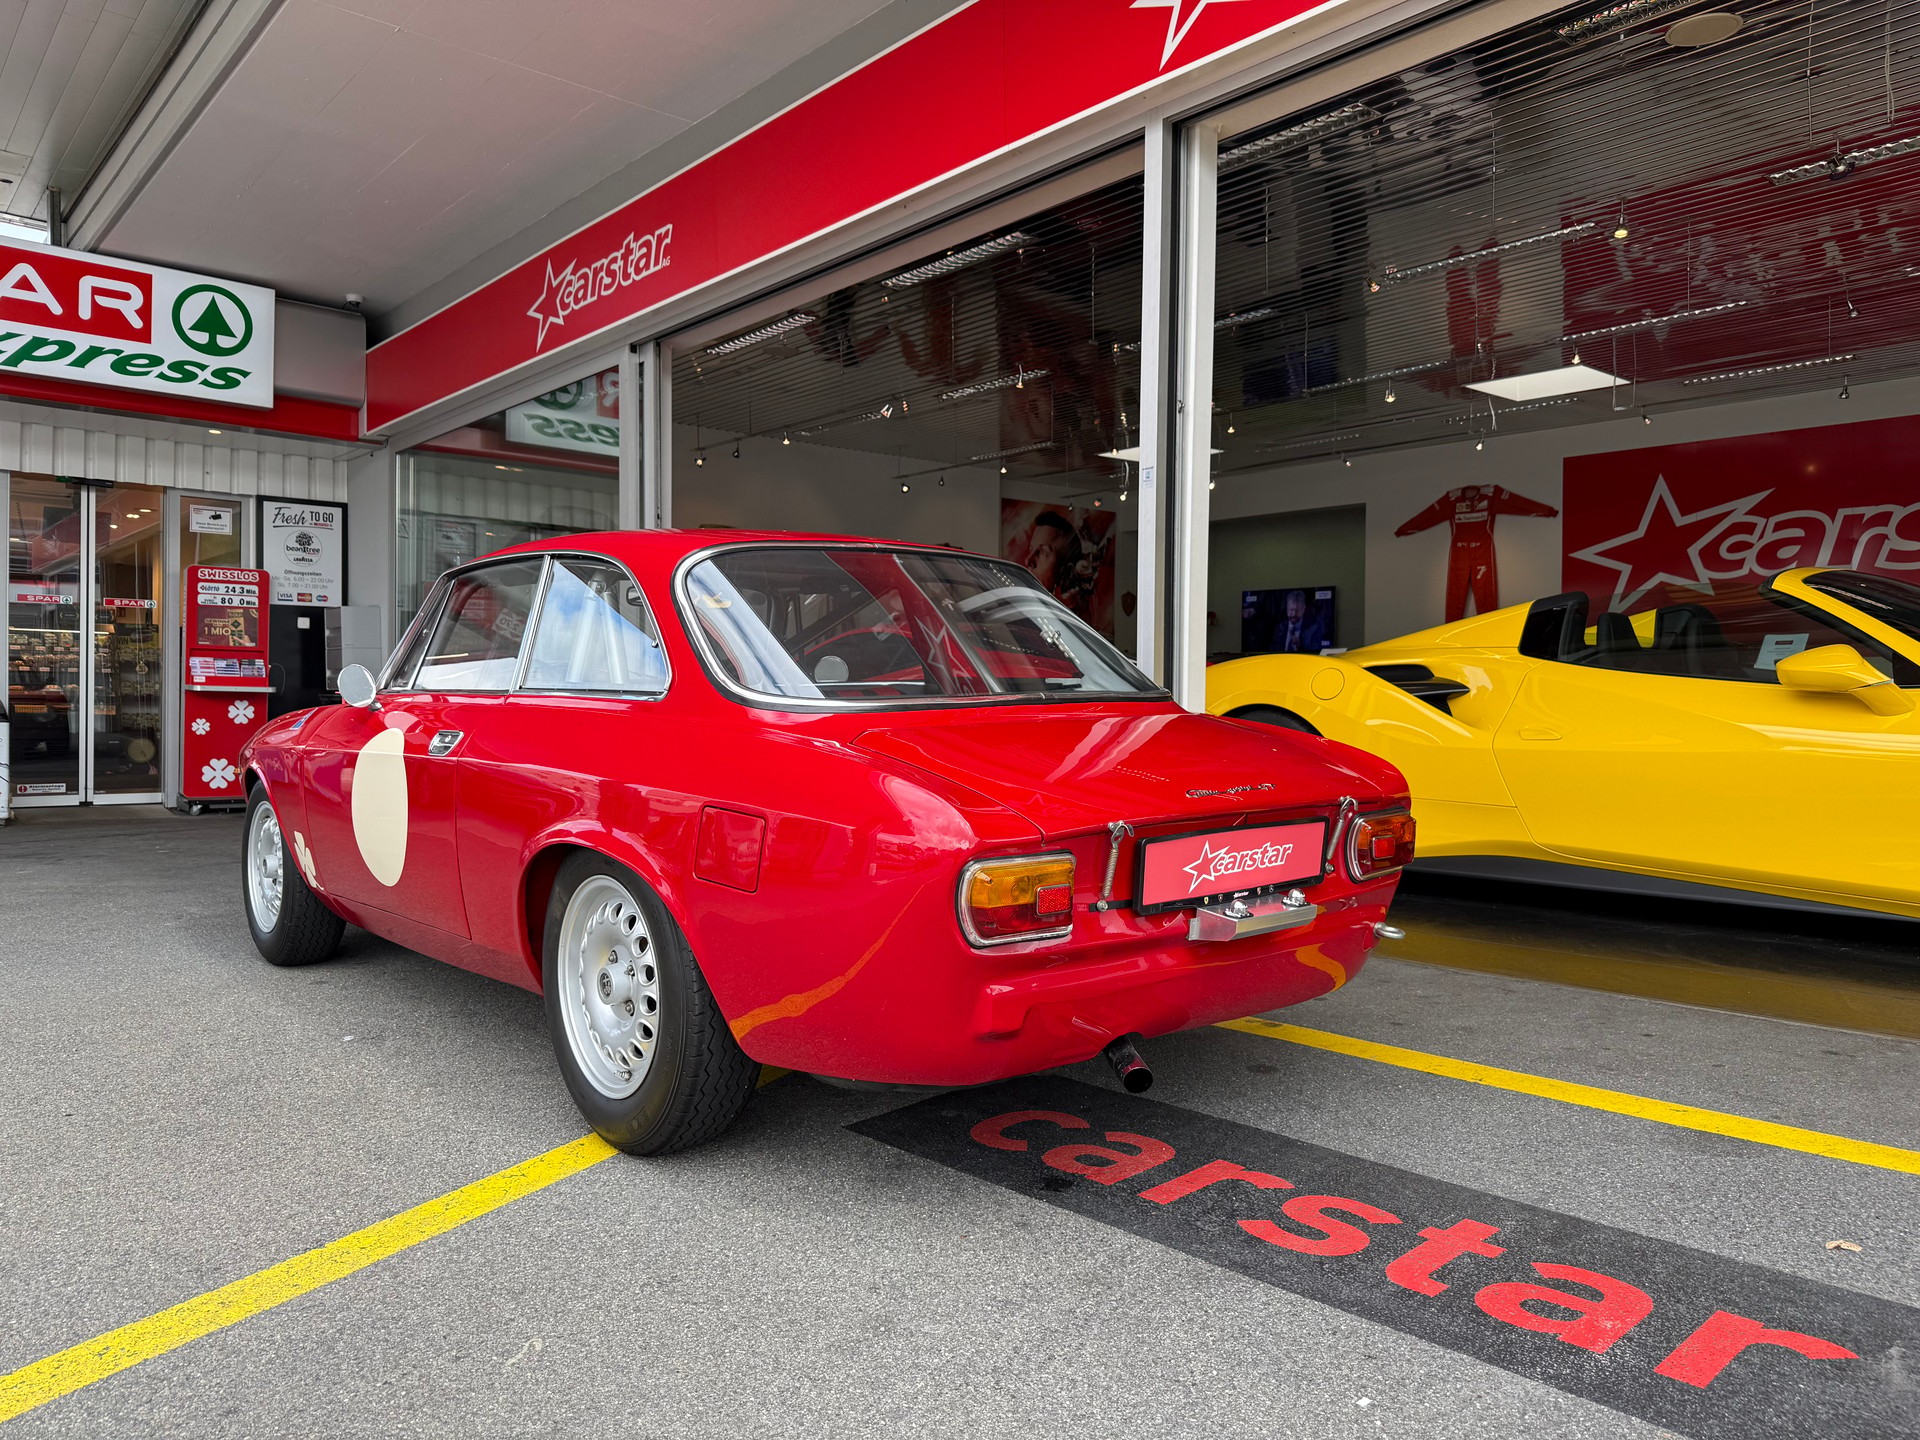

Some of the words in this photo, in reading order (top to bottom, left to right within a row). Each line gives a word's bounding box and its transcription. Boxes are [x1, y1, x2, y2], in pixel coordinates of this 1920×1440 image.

[556, 223, 673, 316] carstar
[661, 256, 671, 268] AG
[272, 506, 307, 525] Fresh
[309, 510, 321, 521] TO
[322, 511, 334, 523] GO
[199, 569, 258, 580] SWISSLOS
[1476, 565, 1487, 579] 7
[114, 599, 145, 607] SPAR
[211, 627, 231, 635] MIO
[1211, 841, 1293, 876] carstar
[969, 1110, 1860, 1389] carstar
